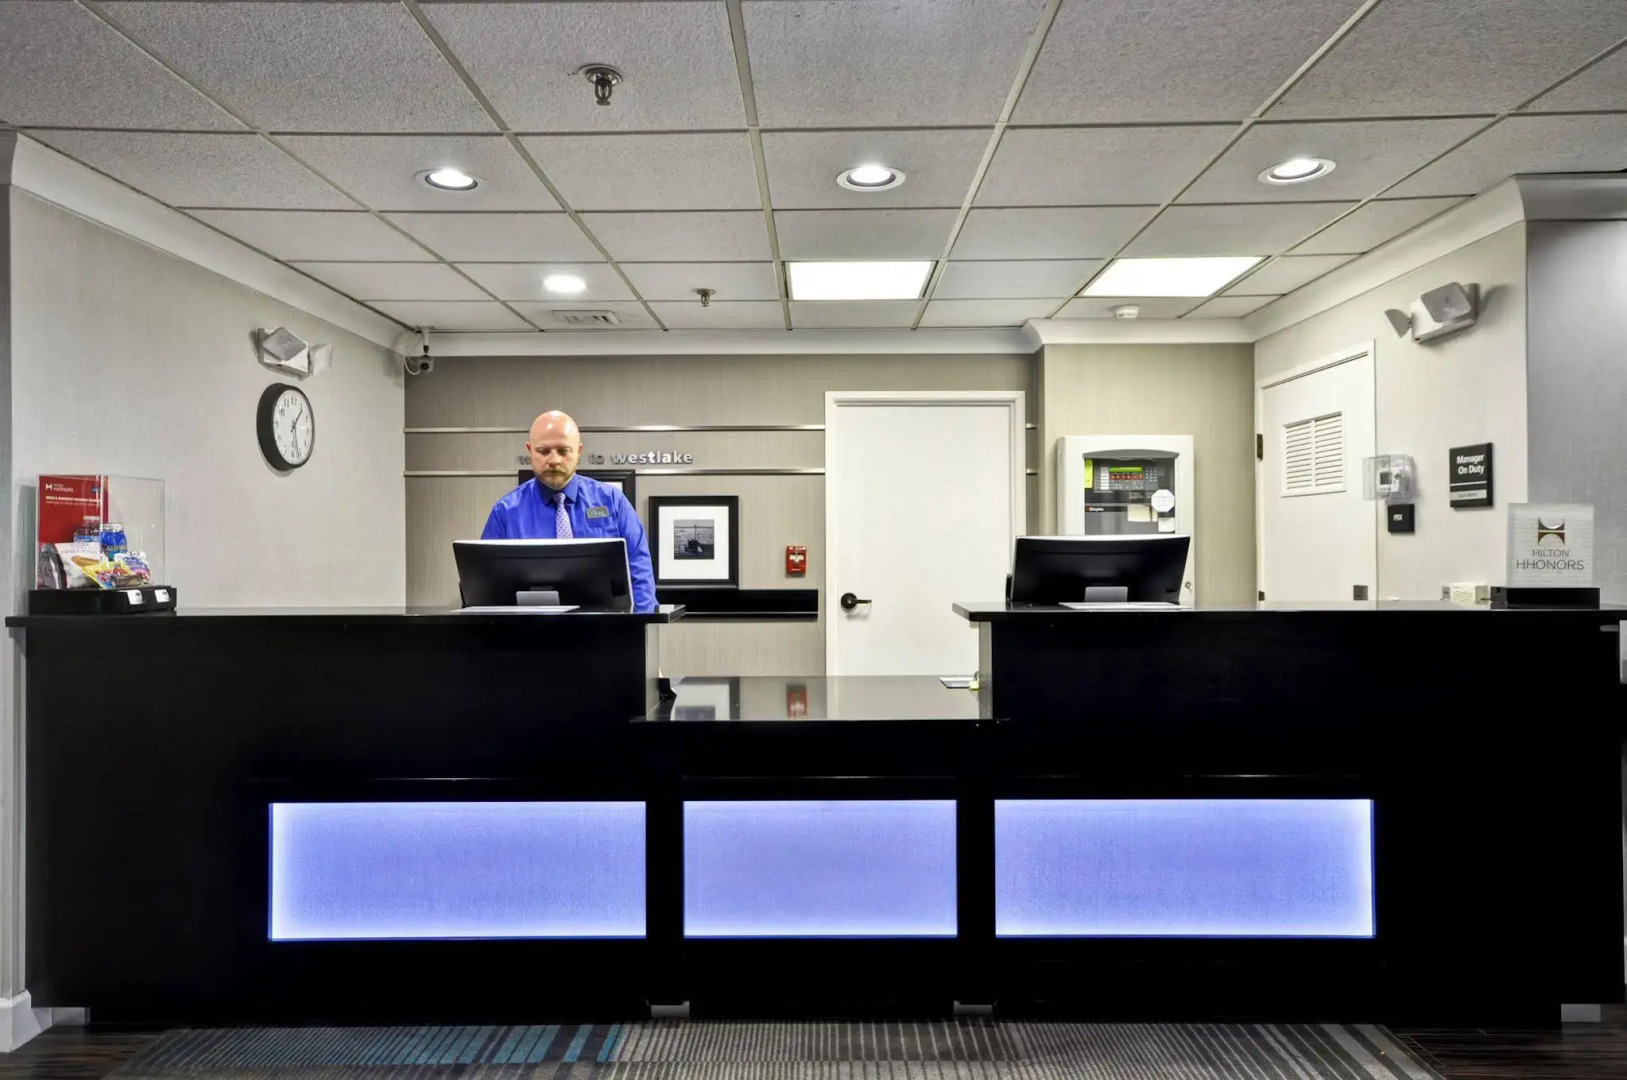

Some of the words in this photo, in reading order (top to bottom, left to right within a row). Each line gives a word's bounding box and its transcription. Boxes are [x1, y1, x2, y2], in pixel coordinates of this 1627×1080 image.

[588, 453, 605, 465] to
[613, 450, 694, 465] westlake
[1456, 454, 1485, 465] Manager
[1458, 466, 1468, 475] On
[1468, 464, 1485, 475] Duty
[1532, 549, 1569, 558] HILTON
[1516, 559, 1585, 571] HHONORS
